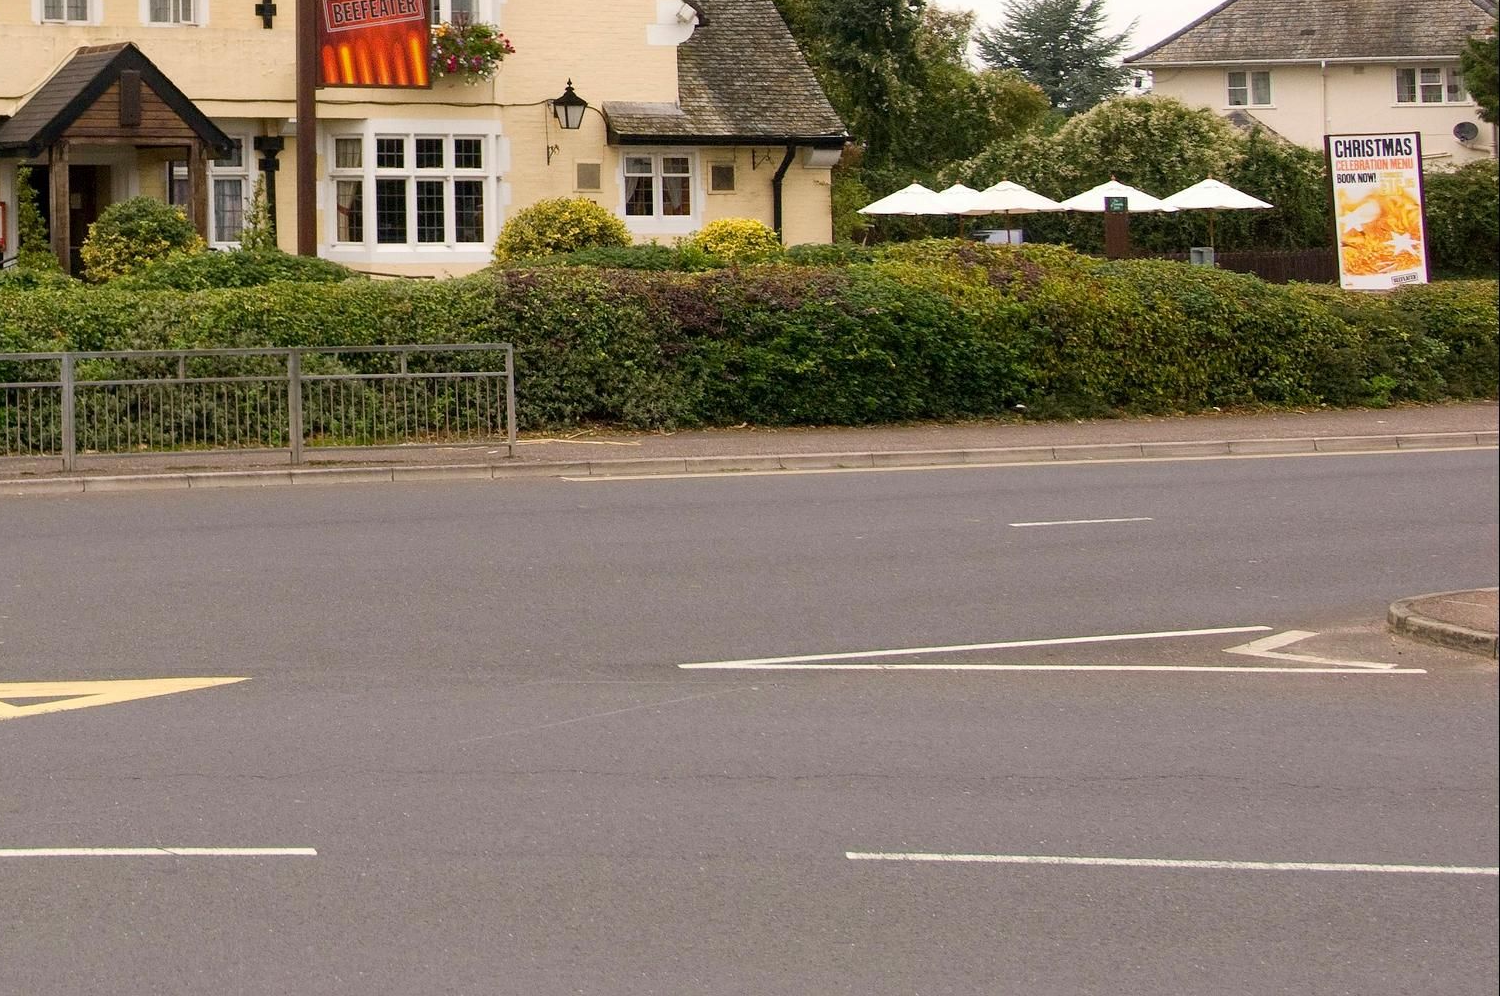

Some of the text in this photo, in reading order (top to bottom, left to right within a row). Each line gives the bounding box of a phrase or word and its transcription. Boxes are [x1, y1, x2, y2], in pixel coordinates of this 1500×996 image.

[1334, 138, 1413, 158] CHRISTMAS
[1336, 158, 1414, 171] CELEBRATION MENU
[1337, 173, 1356, 183] BOOK
[1357, 172, 1377, 183] NOW!
